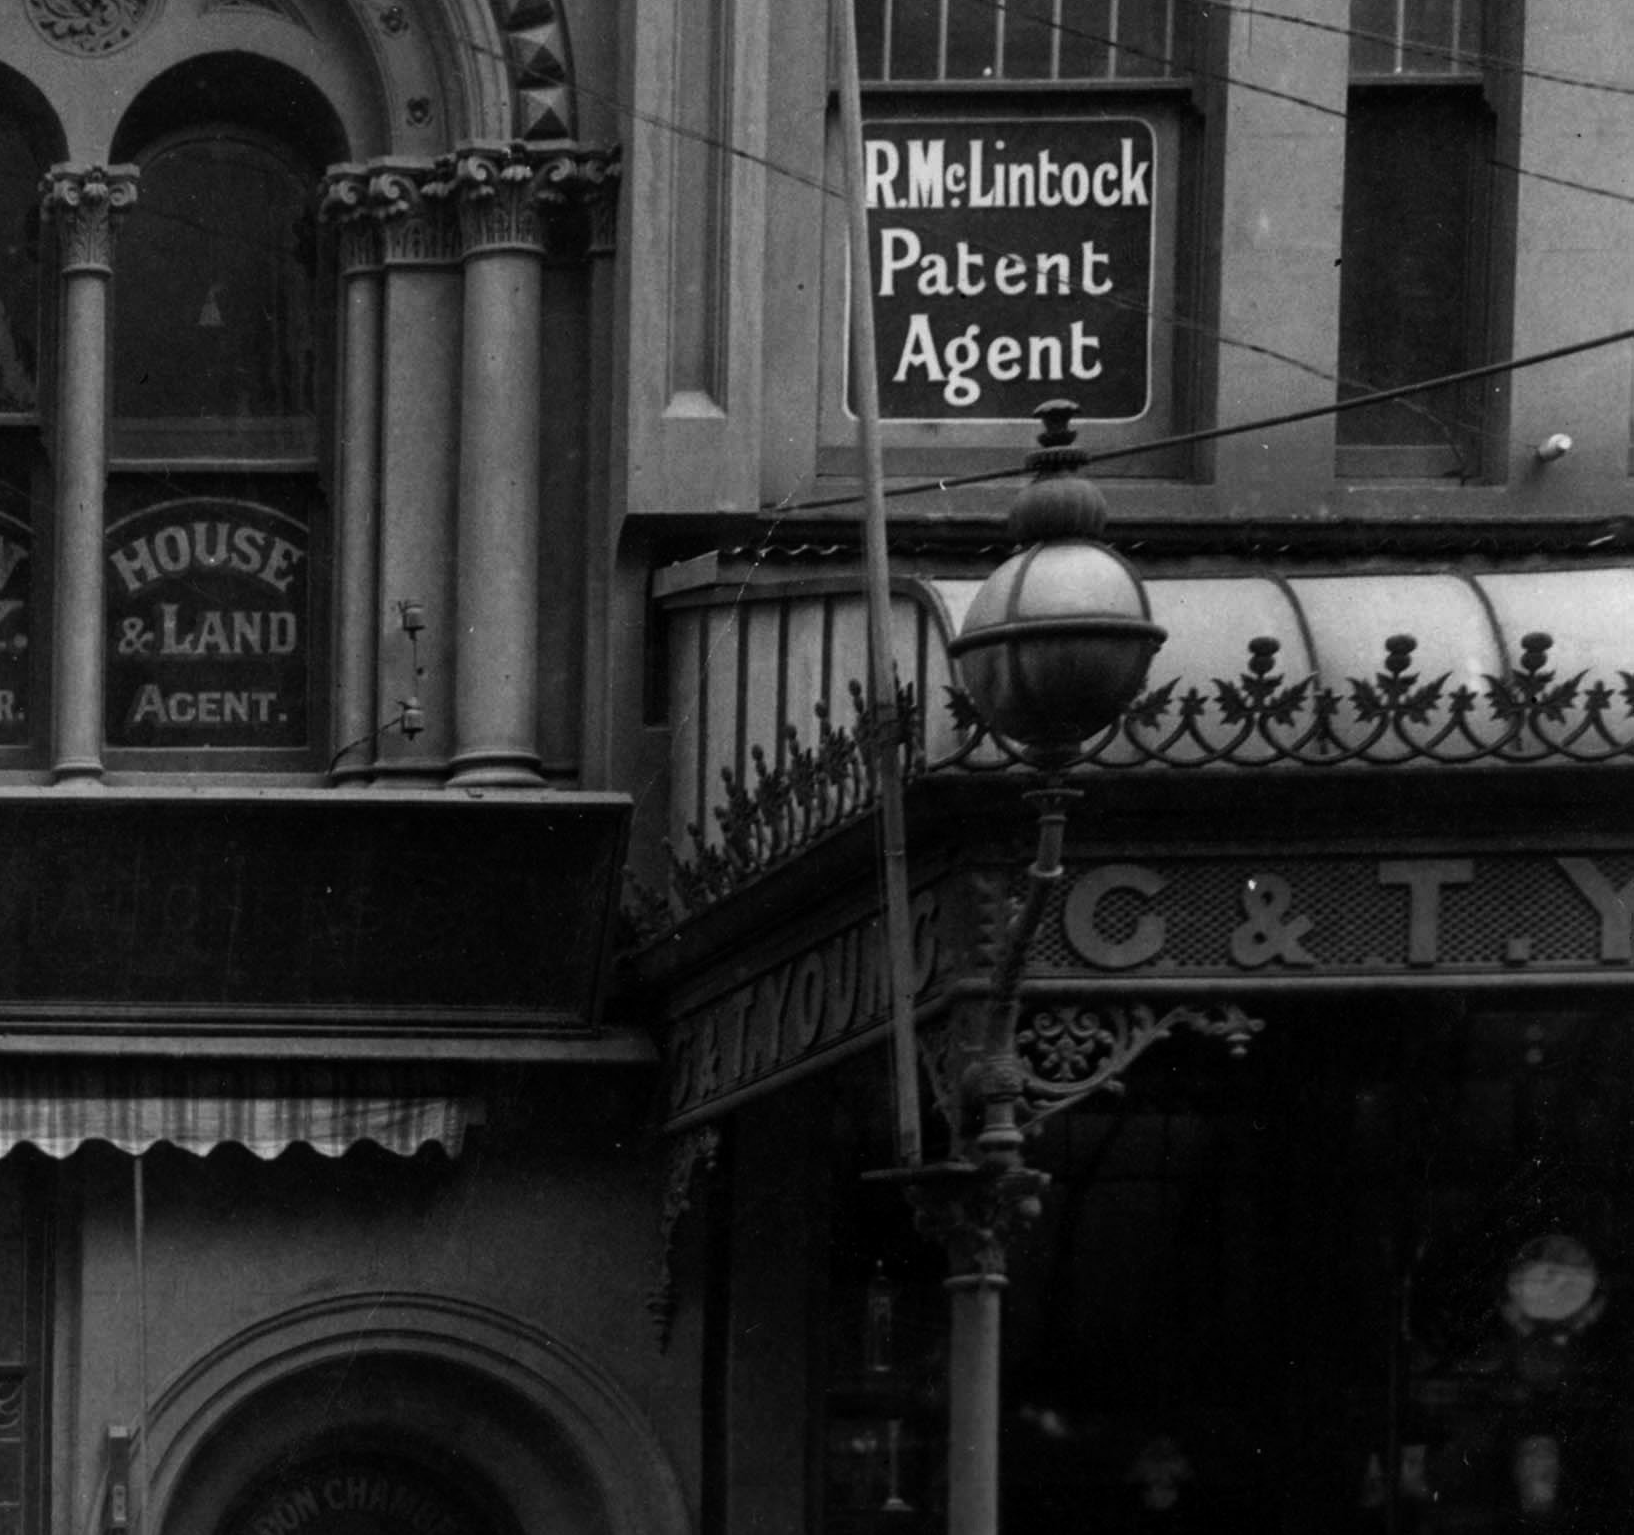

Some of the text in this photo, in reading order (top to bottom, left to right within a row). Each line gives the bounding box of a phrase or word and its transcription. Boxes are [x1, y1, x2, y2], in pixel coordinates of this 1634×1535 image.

[879, 228, 1113, 297] Patent
[893, 314, 1103, 407] Agent
[110, 521, 304, 592] HOUSE
[118, 603, 298, 656] & LAND
[1231, 872, 1315, 967] &
